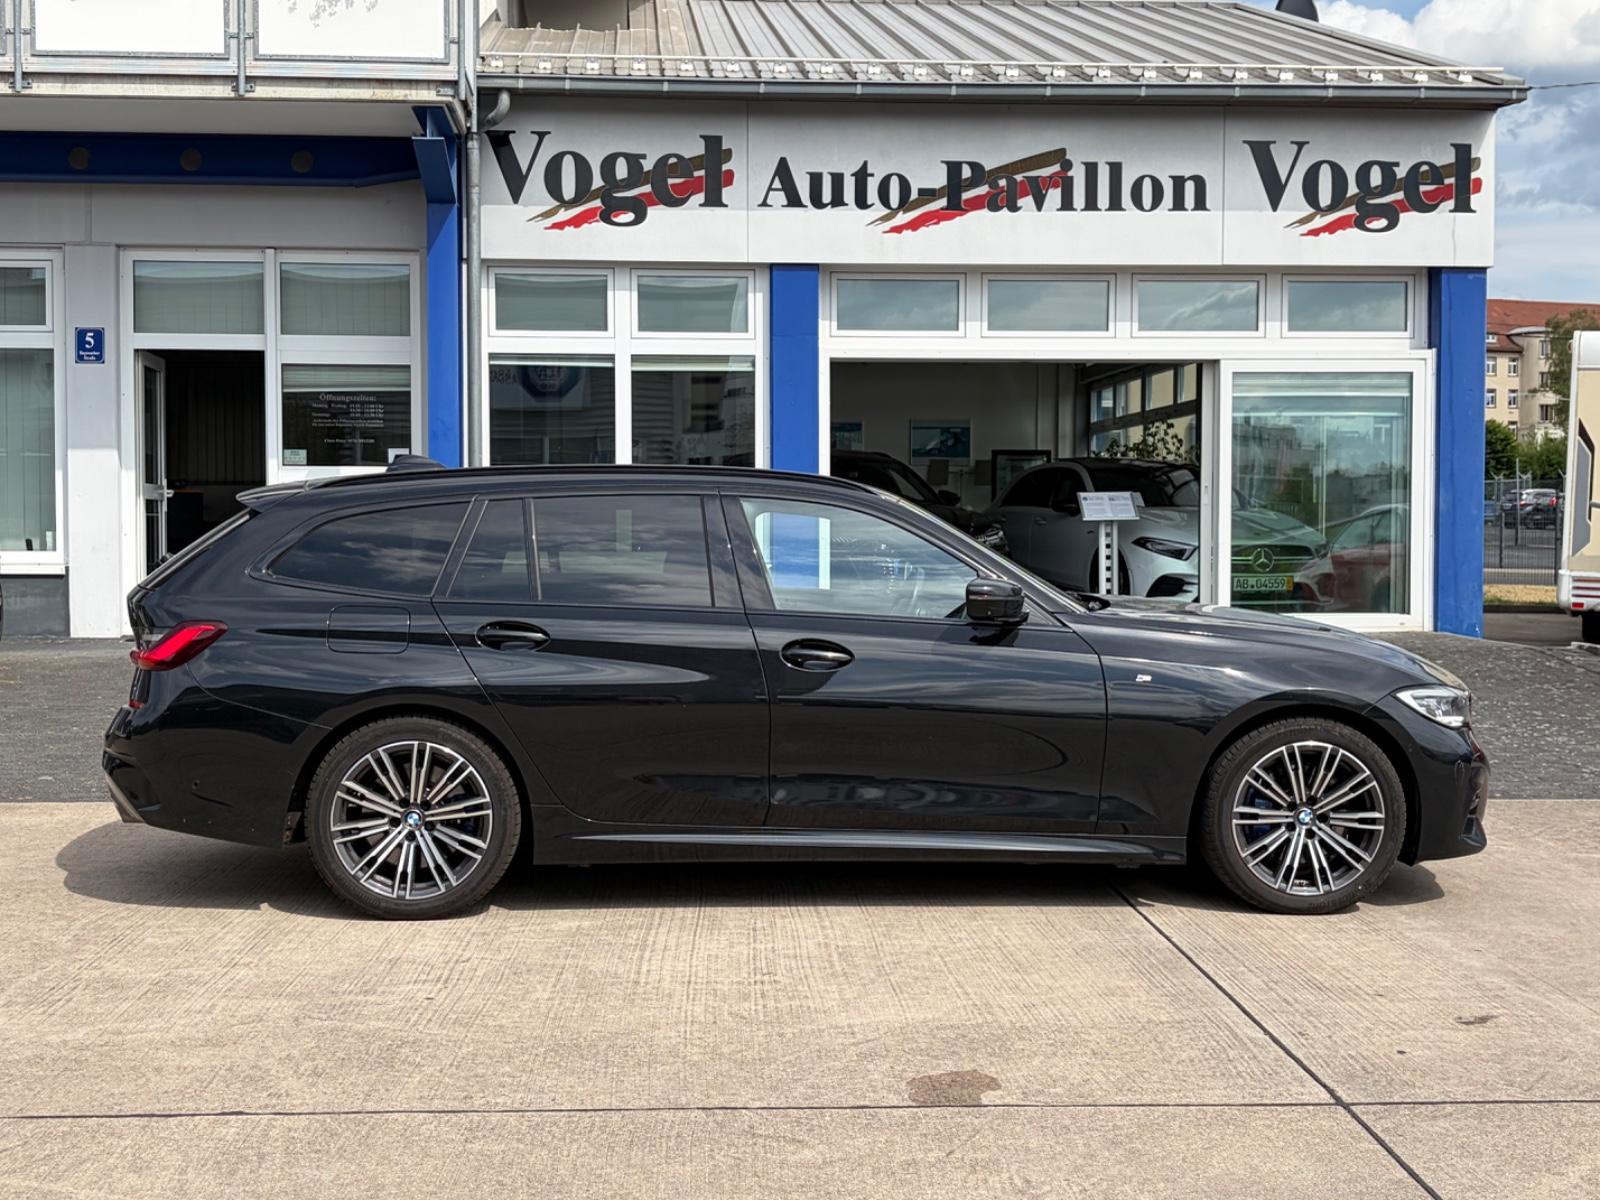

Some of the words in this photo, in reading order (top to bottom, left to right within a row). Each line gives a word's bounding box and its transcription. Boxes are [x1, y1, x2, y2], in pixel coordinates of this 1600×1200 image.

[484, 130, 729, 227] Vogel
[757, 156, 1211, 213] Auto-Pavillon
[1242, 140, 1477, 232] Vogel
[85, 332, 94, 348] 5
[1235, 578, 1249, 589] AB
